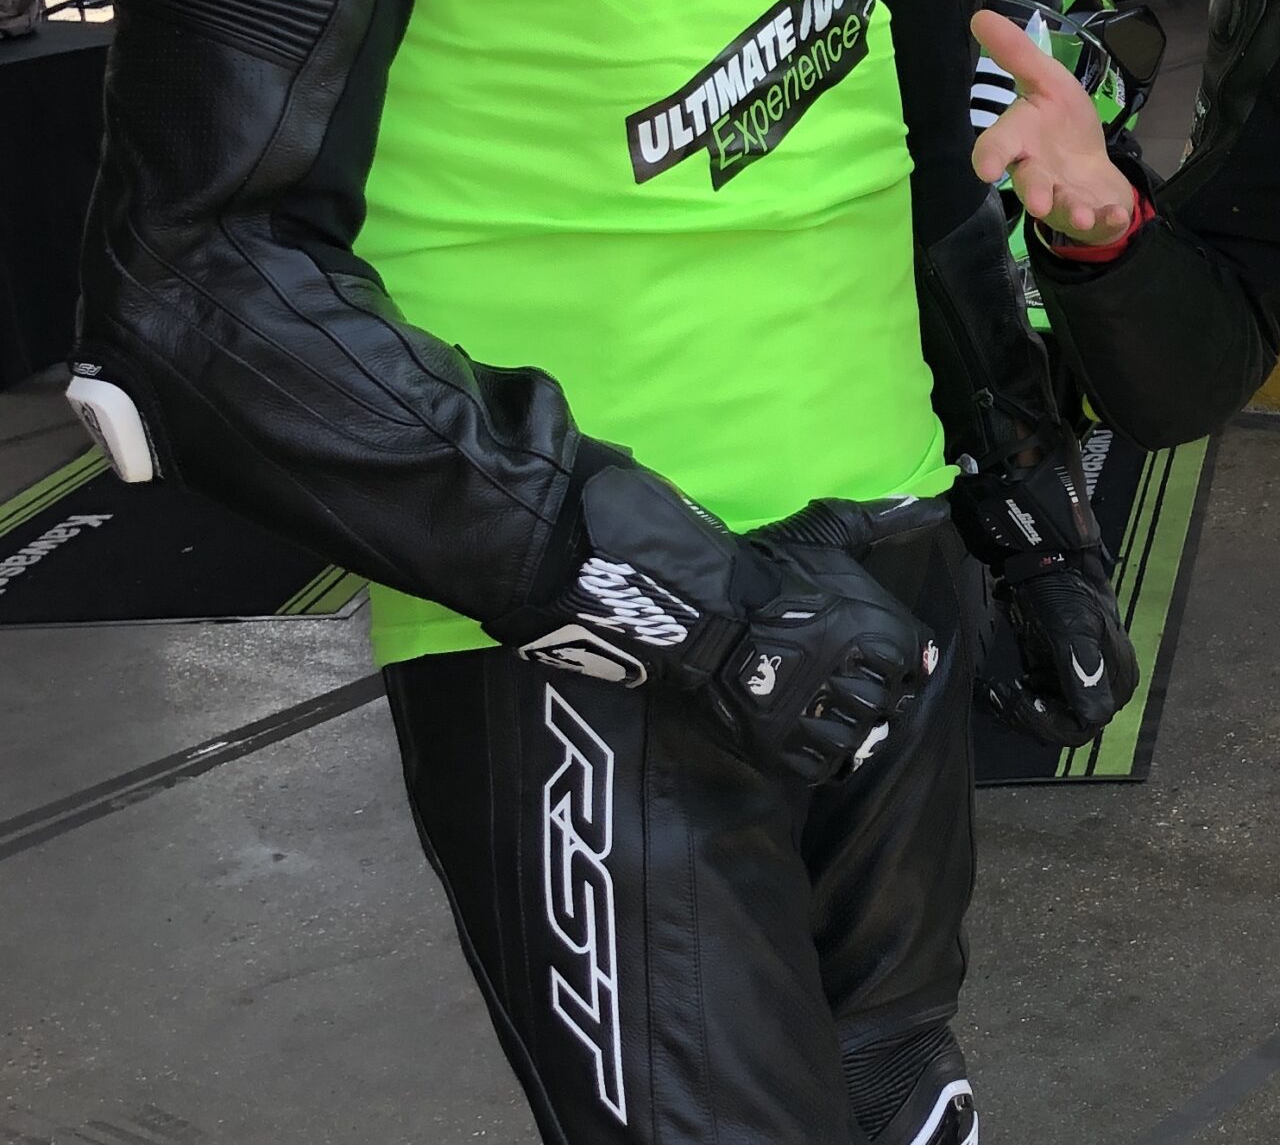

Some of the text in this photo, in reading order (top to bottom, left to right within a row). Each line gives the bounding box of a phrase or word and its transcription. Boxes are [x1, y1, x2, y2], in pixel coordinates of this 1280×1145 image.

[637, 6, 797, 164] ULTIMATE
[711, 13, 861, 171] Experience
[0, 513, 114, 595] Kawas
[545, 682, 628, 1127] RST
